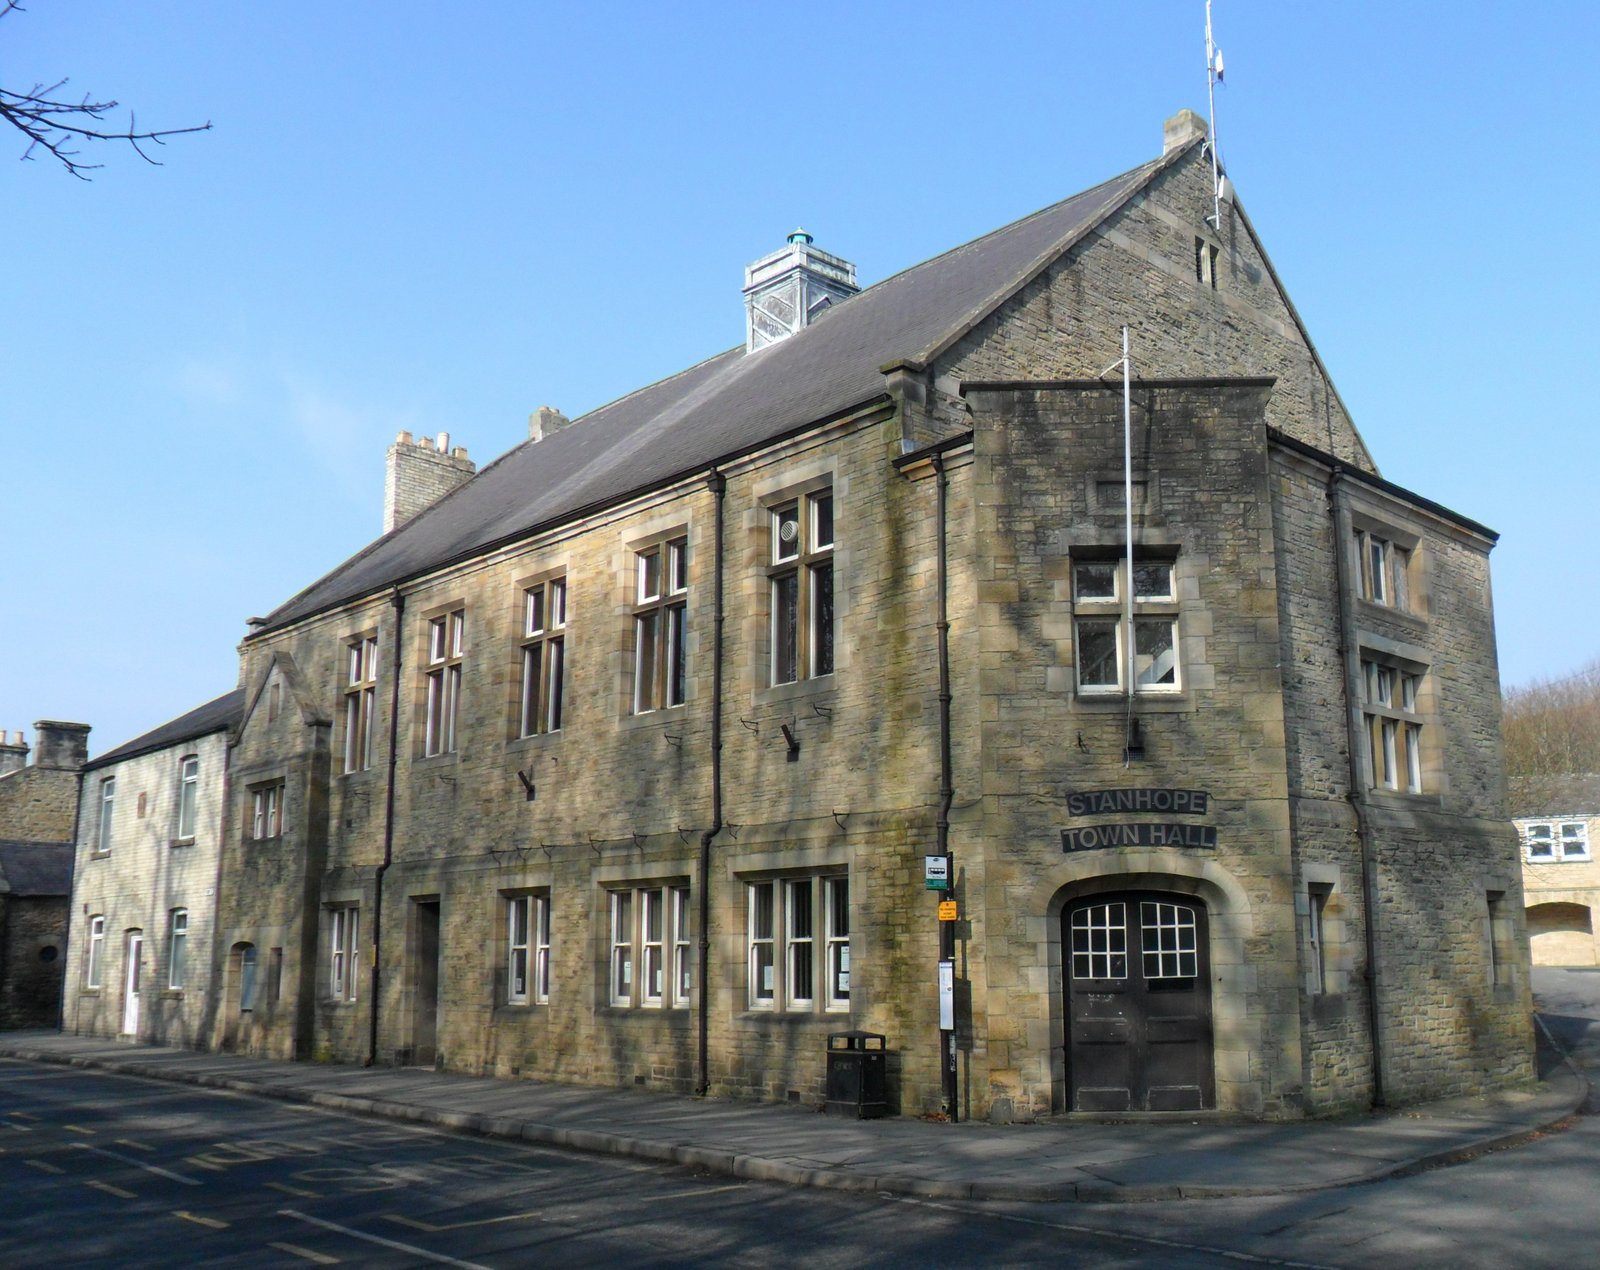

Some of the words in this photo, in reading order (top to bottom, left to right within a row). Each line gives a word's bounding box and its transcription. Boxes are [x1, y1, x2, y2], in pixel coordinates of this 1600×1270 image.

[1069, 790, 1205, 814] STANHOPE
[1063, 825, 1139, 850] TOWN
[1150, 825, 1214, 847] HALL
